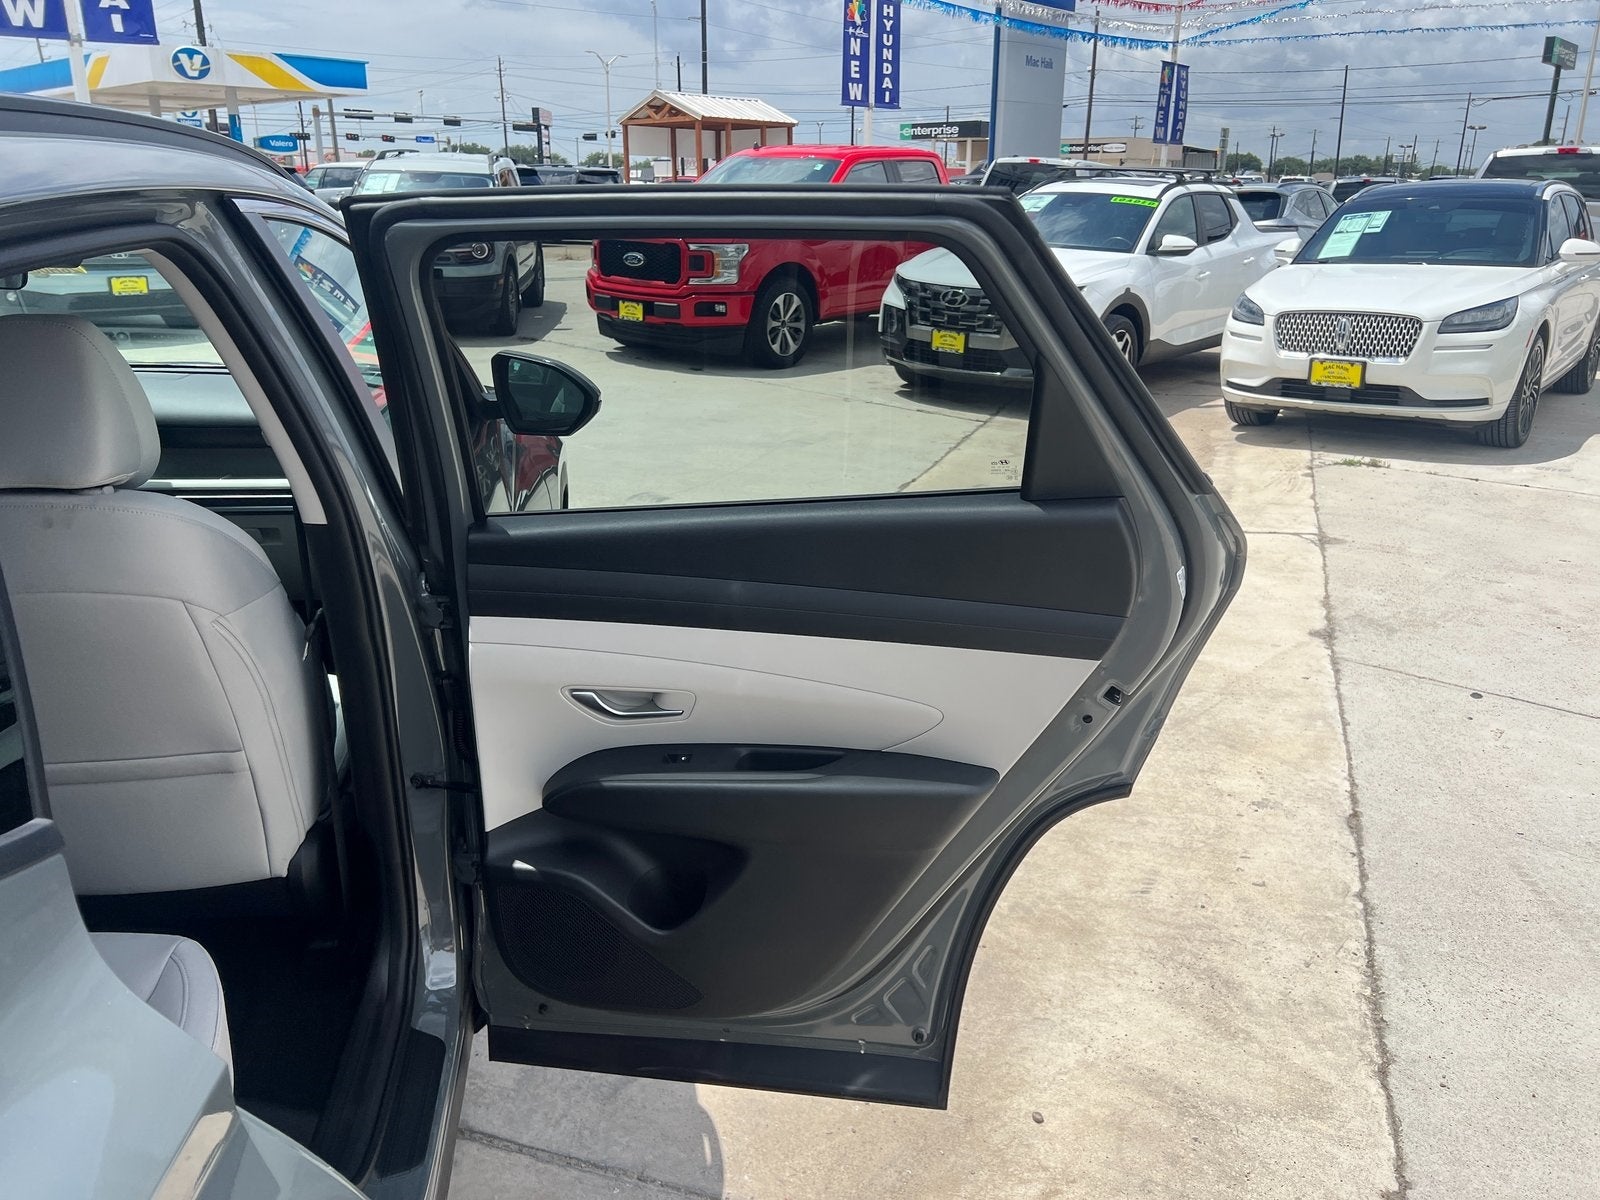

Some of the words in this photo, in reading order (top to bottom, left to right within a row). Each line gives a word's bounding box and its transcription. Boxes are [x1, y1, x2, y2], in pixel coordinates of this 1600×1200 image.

[882, 4, 895, 103] HYUNDAI
[1025, 54, 1040, 68] Mac
[848, 37, 863, 101] NEW
[1155, 94, 1167, 139] NEW
[1176, 70, 1187, 140] HYUNDAI
[269, 139, 294, 147] Valero
[903, 125, 959, 137] enterprise
[1063, 144, 1101, 152] enterrise
